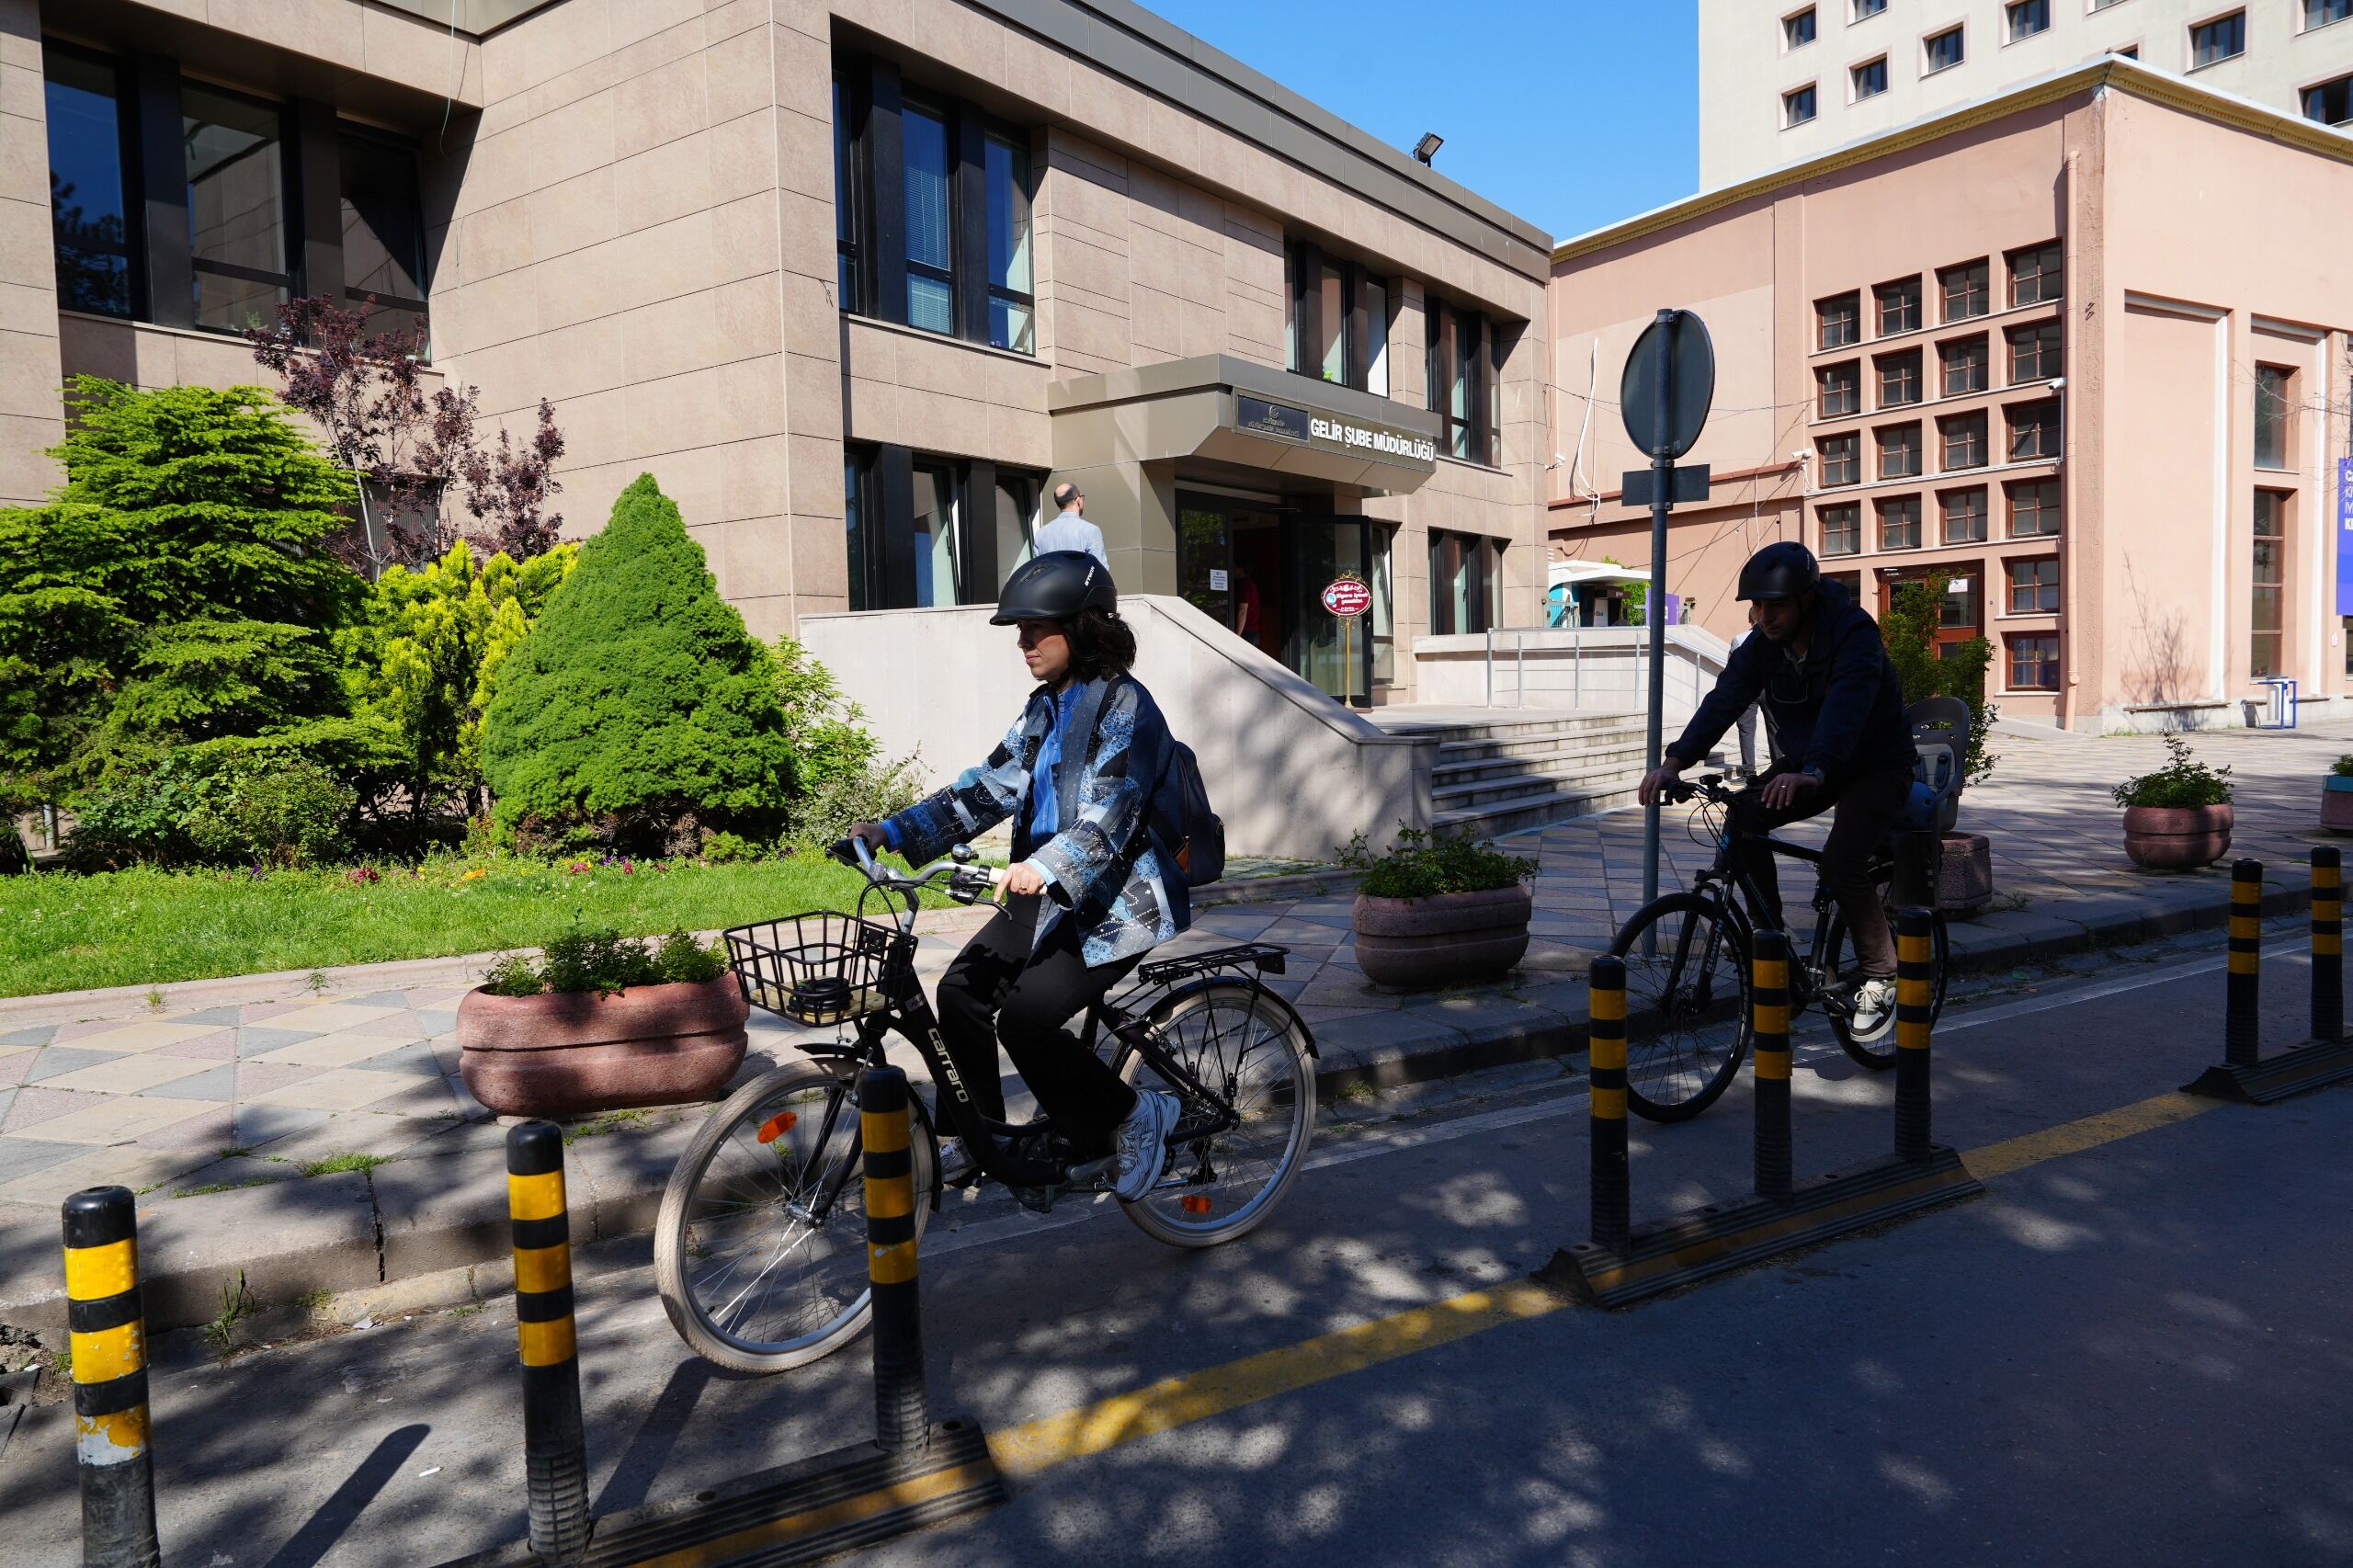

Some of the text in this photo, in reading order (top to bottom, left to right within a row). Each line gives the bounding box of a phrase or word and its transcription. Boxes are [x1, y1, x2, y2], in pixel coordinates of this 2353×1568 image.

[1311, 418, 1342, 442] GELİR
[1345, 426, 1373, 449] ŞUBE
[1373, 431, 1434, 461] MÜDÜRLÜĞÜ
